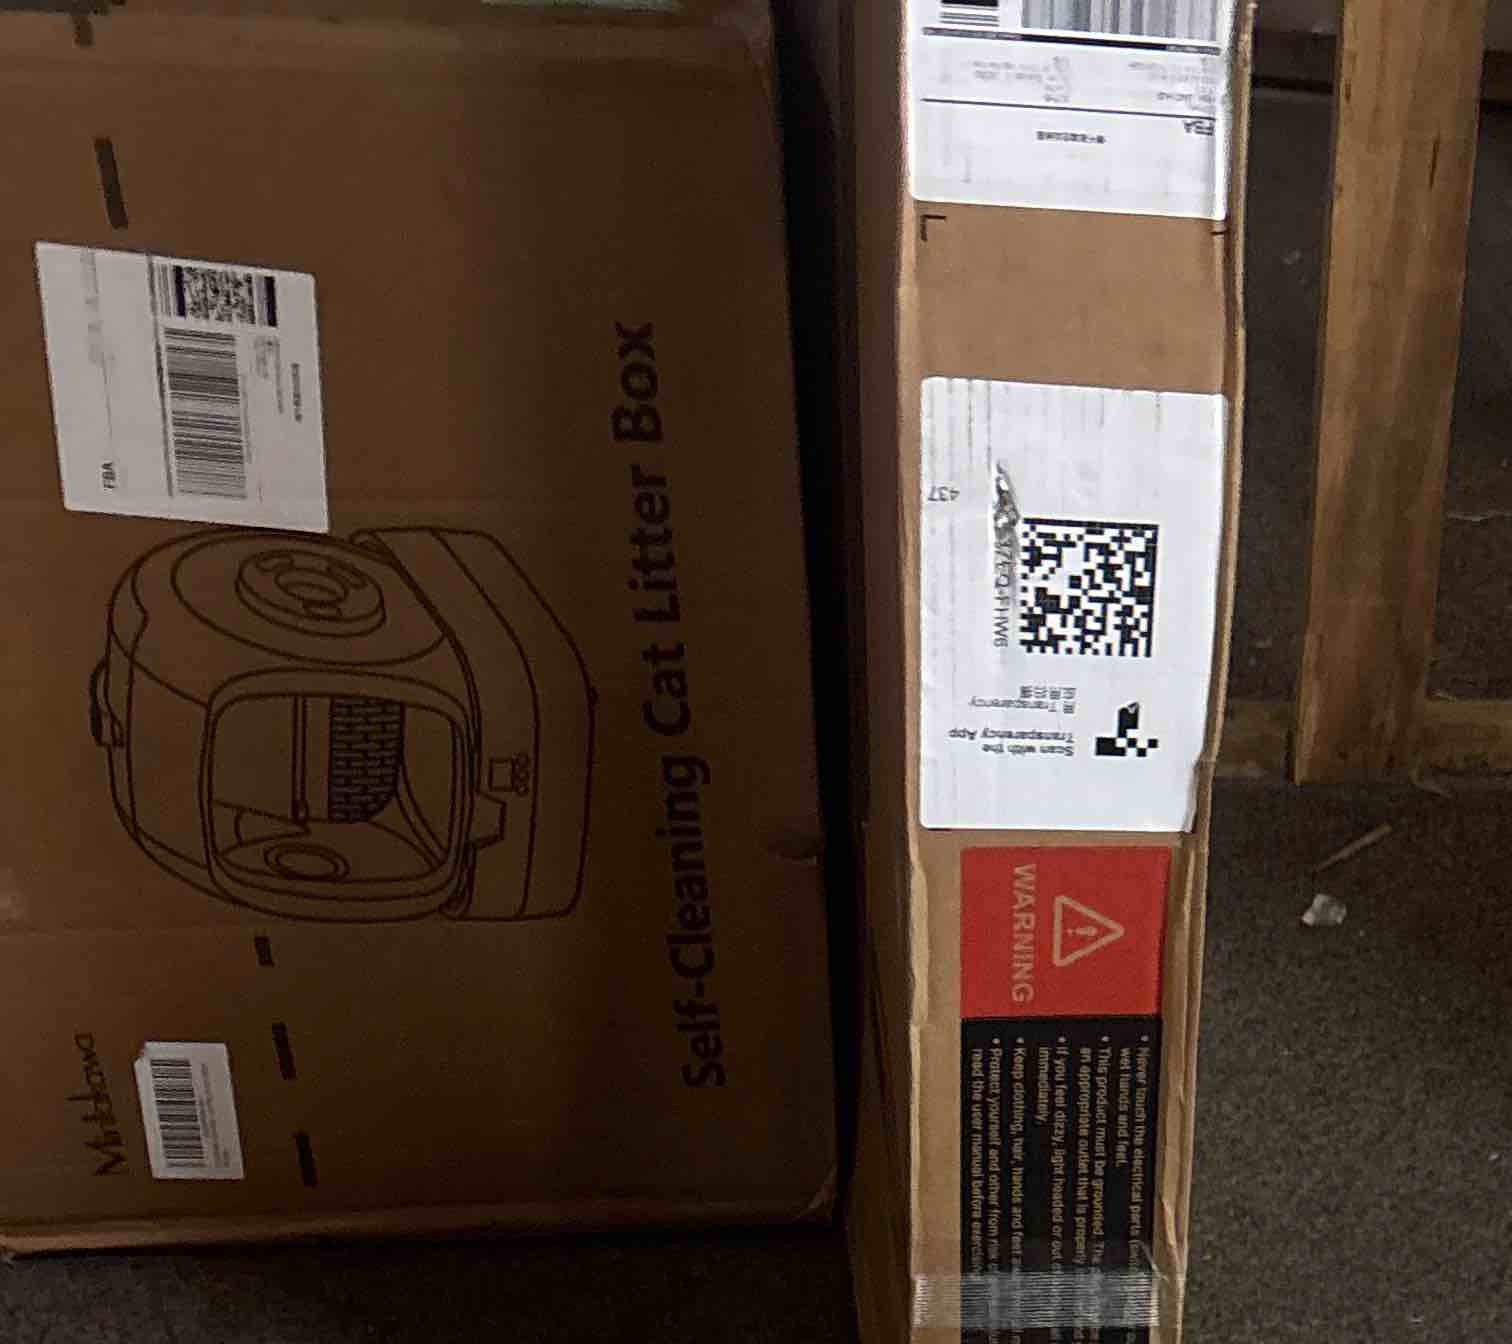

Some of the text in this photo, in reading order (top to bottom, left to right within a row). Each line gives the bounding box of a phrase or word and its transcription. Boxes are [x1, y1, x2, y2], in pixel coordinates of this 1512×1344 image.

[609, 321, 729, 1088] Self-Cleaning Cat Litter Box
[948, 727, 1074, 743] Transparency App
[981, 743, 1074, 757] Scan with the
[1011, 864, 1037, 1003] WARNING
[970, 1049, 983, 1077] read
[989, 1048, 1002, 1093] Protect
[1012, 1048, 1026, 1079] Keep
[1052, 1058, 1065, 1080] you
[1097, 1048, 1111, 1073] This
[1118, 1048, 1129, 1069] wet
[1136, 1048, 1149, 1084] Never
[970, 1080, 983, 1100] the
[1054, 1085, 1067, 1108] feel
[1076, 1066, 1091, 1135] appropriate
[1092, 1077, 1109, 1123] product
[1118, 1074, 1129, 1111] hands
[970, 1104, 983, 1130] user
[1135, 1088, 1147, 1122] touch
[985, 1096, 1001, 1145] yourself
[1117, 1115, 1128, 1137] and
[1134, 1125, 1146, 1145] the
[970, 1134, 983, 1177] manual
[1078, 1139, 1091, 1174] outlet
[1094, 1128, 1106, 1157] must
[988, 1148, 1000, 1171] and
[1051, 1149, 1064, 1176] light
[1094, 1160, 1105, 1176] be
[1011, 1167, 1024, 1203] hands
[1077, 1177, 1091, 1201] that
[1130, 1148, 1145, 1202] electrical
[970, 1180, 984, 1218] before
[987, 1174, 1000, 1206] other
[1051, 1179, 1064, 1222] headed
[987, 1210, 1000, 1236] from
[1011, 1207, 1023, 1228] and
[1129, 1205, 1143, 1236] parts
[1011, 1232, 1023, 1255] feet
[1052, 1240, 1063, 1259] out
[1072, 1217, 1088, 1265] properly
